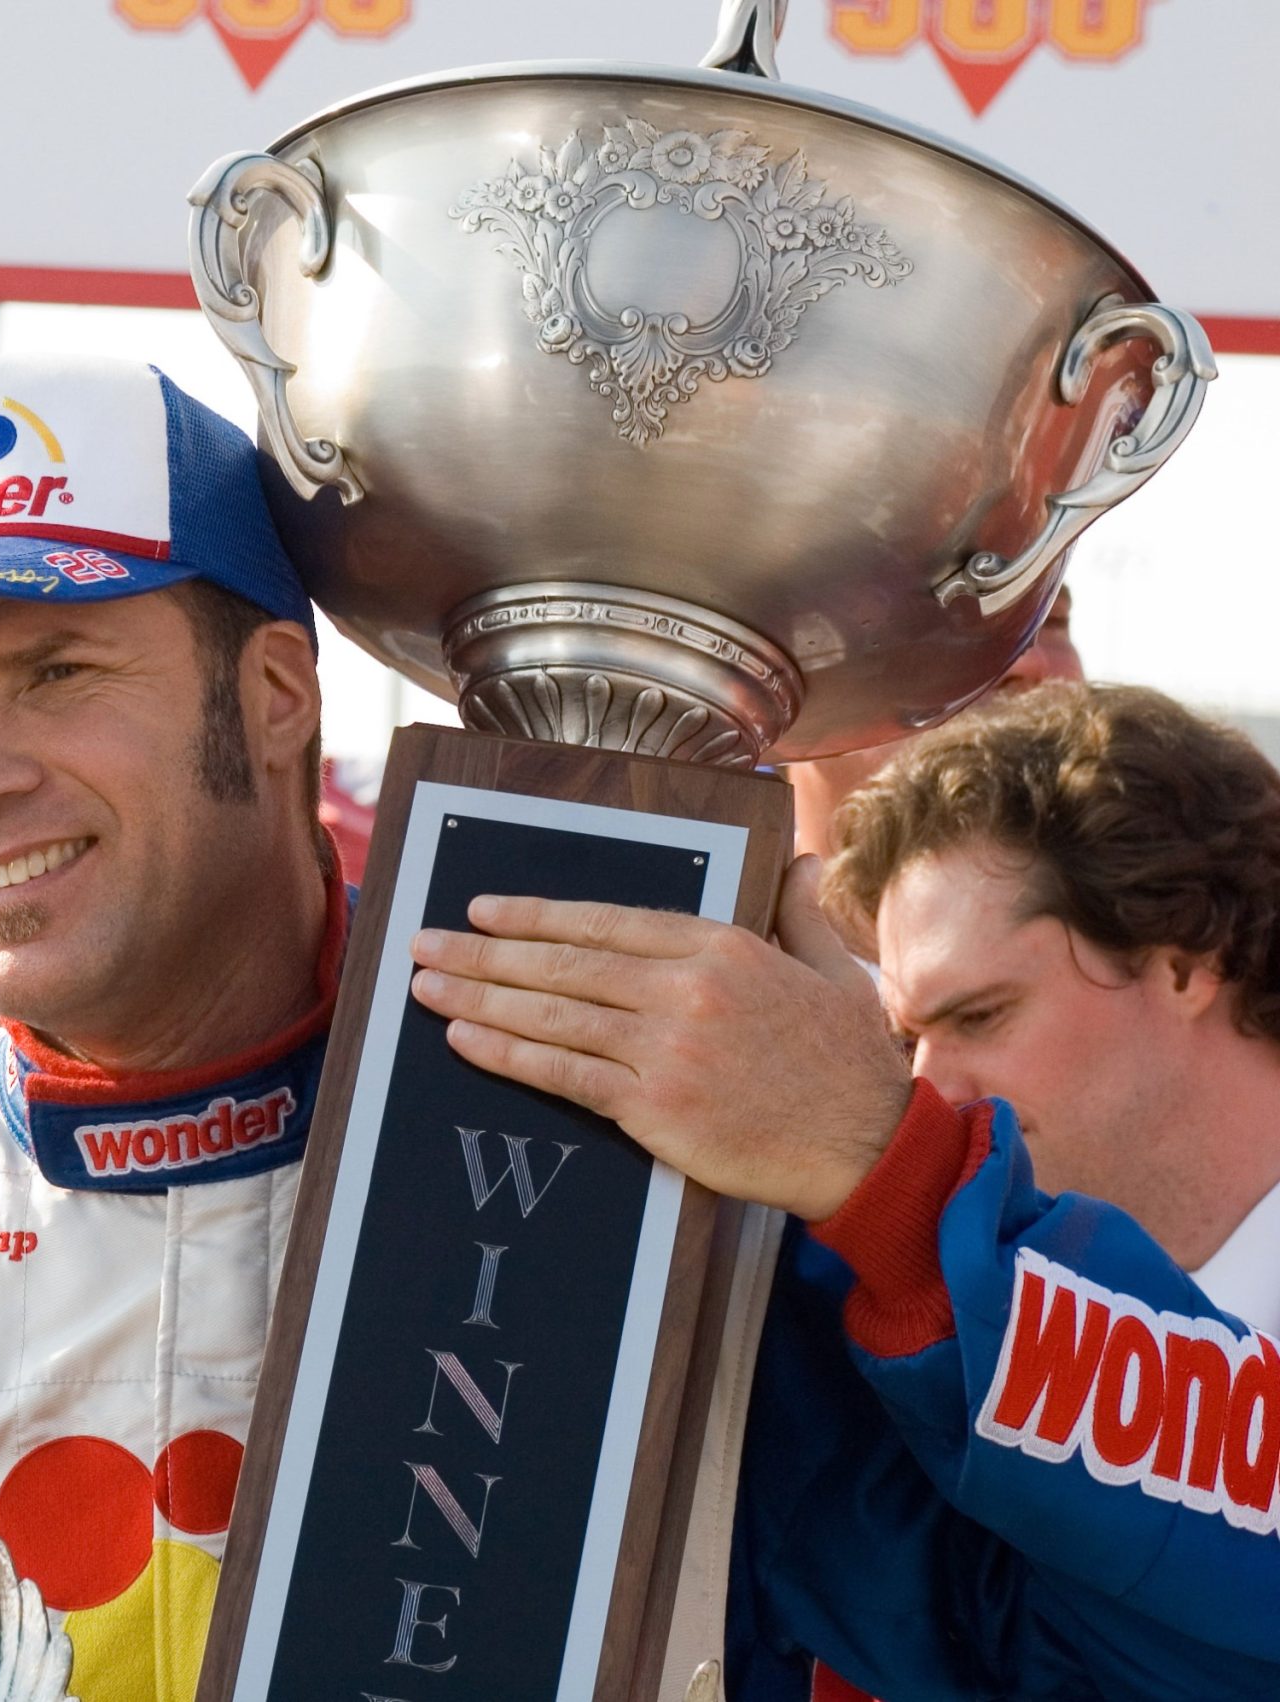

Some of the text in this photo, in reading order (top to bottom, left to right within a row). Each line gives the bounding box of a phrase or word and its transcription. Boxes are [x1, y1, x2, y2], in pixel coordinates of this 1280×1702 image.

[42, 548, 129, 585] 26
[80, 1090, 294, 1174] wonder
[360, 1125, 582, 1702] WINNE
